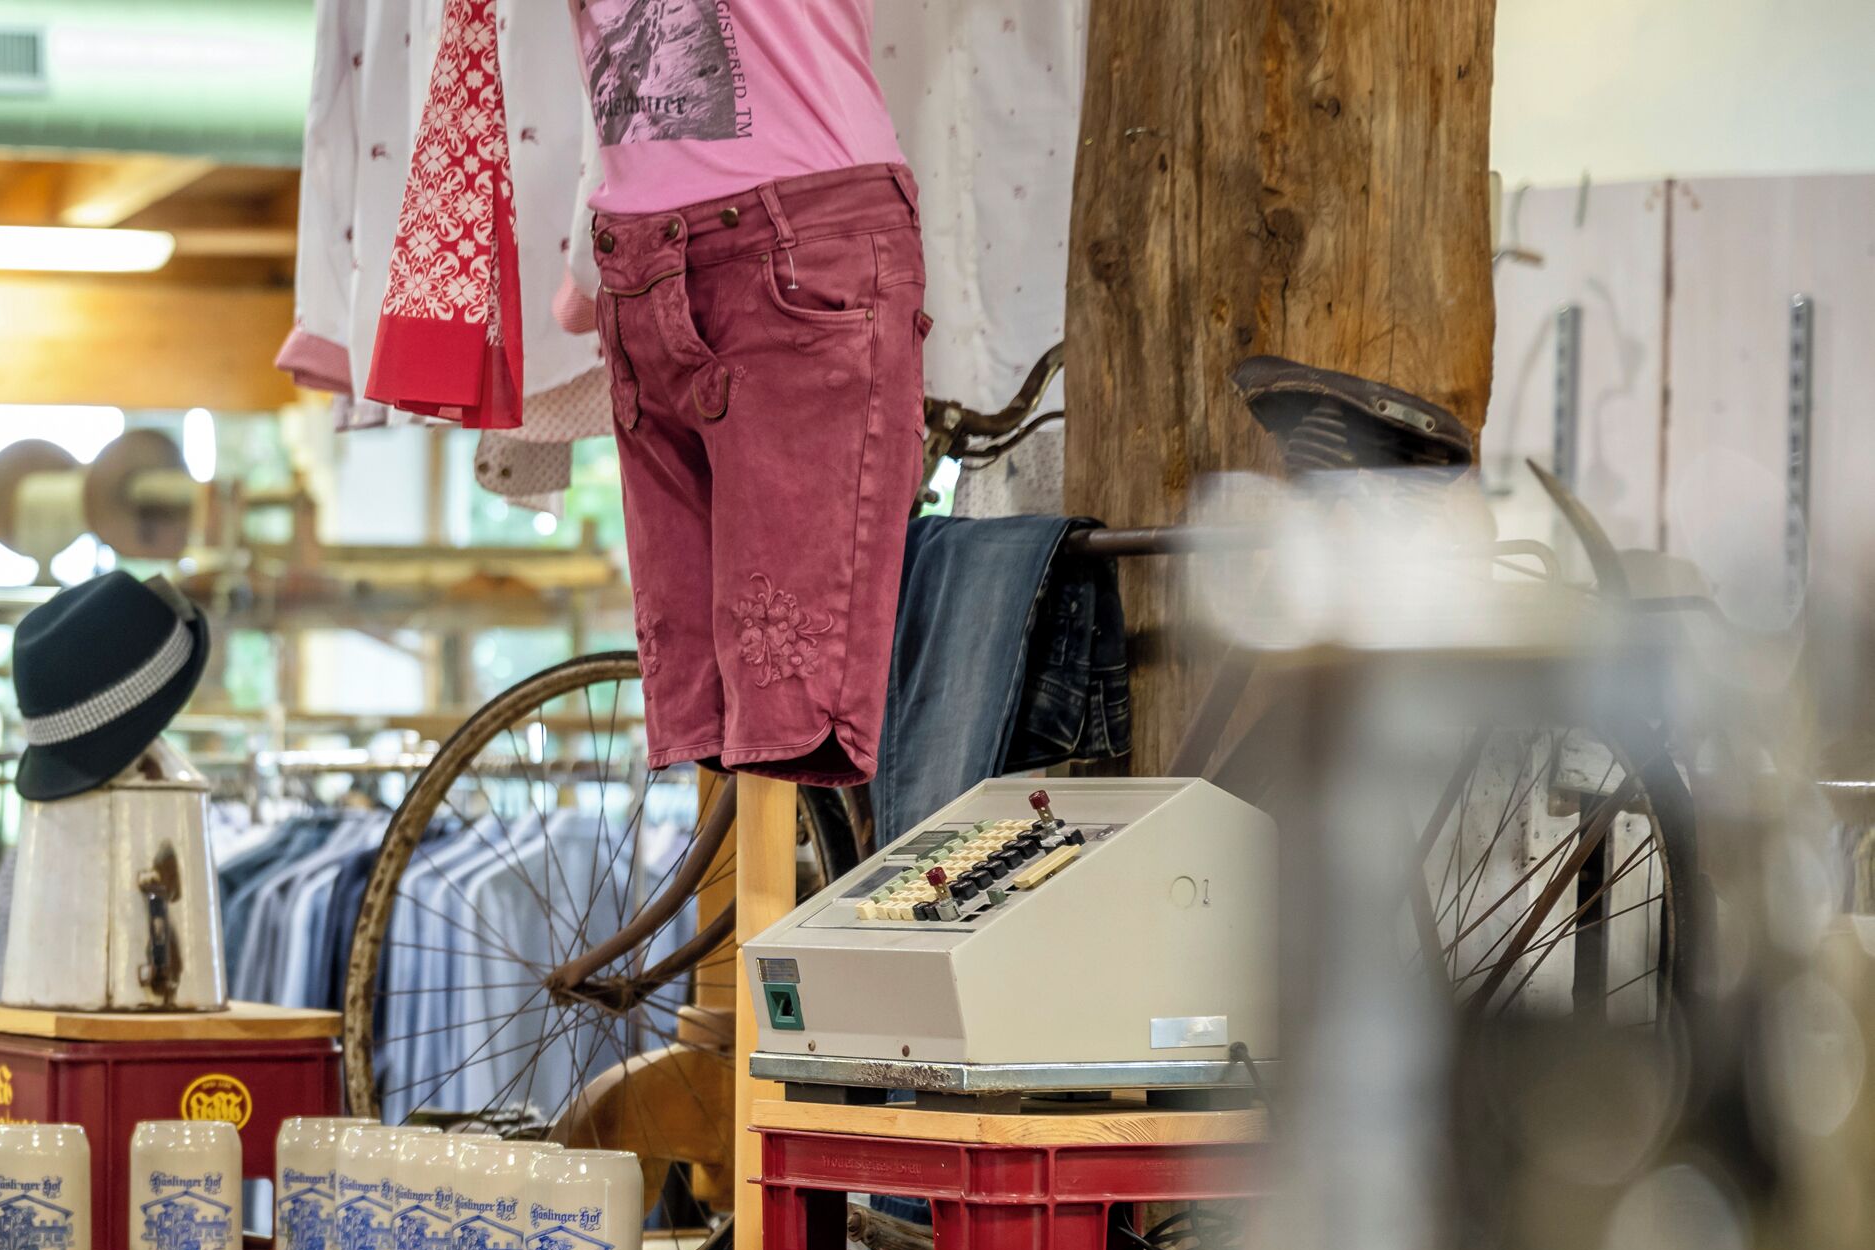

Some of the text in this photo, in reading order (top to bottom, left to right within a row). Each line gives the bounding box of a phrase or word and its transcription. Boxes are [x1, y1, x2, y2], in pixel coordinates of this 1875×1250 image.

[736, 107, 753, 138] TM
[495, 1197, 518, 1221] Hof
[530, 1202, 602, 1232] Haslinger Hof
